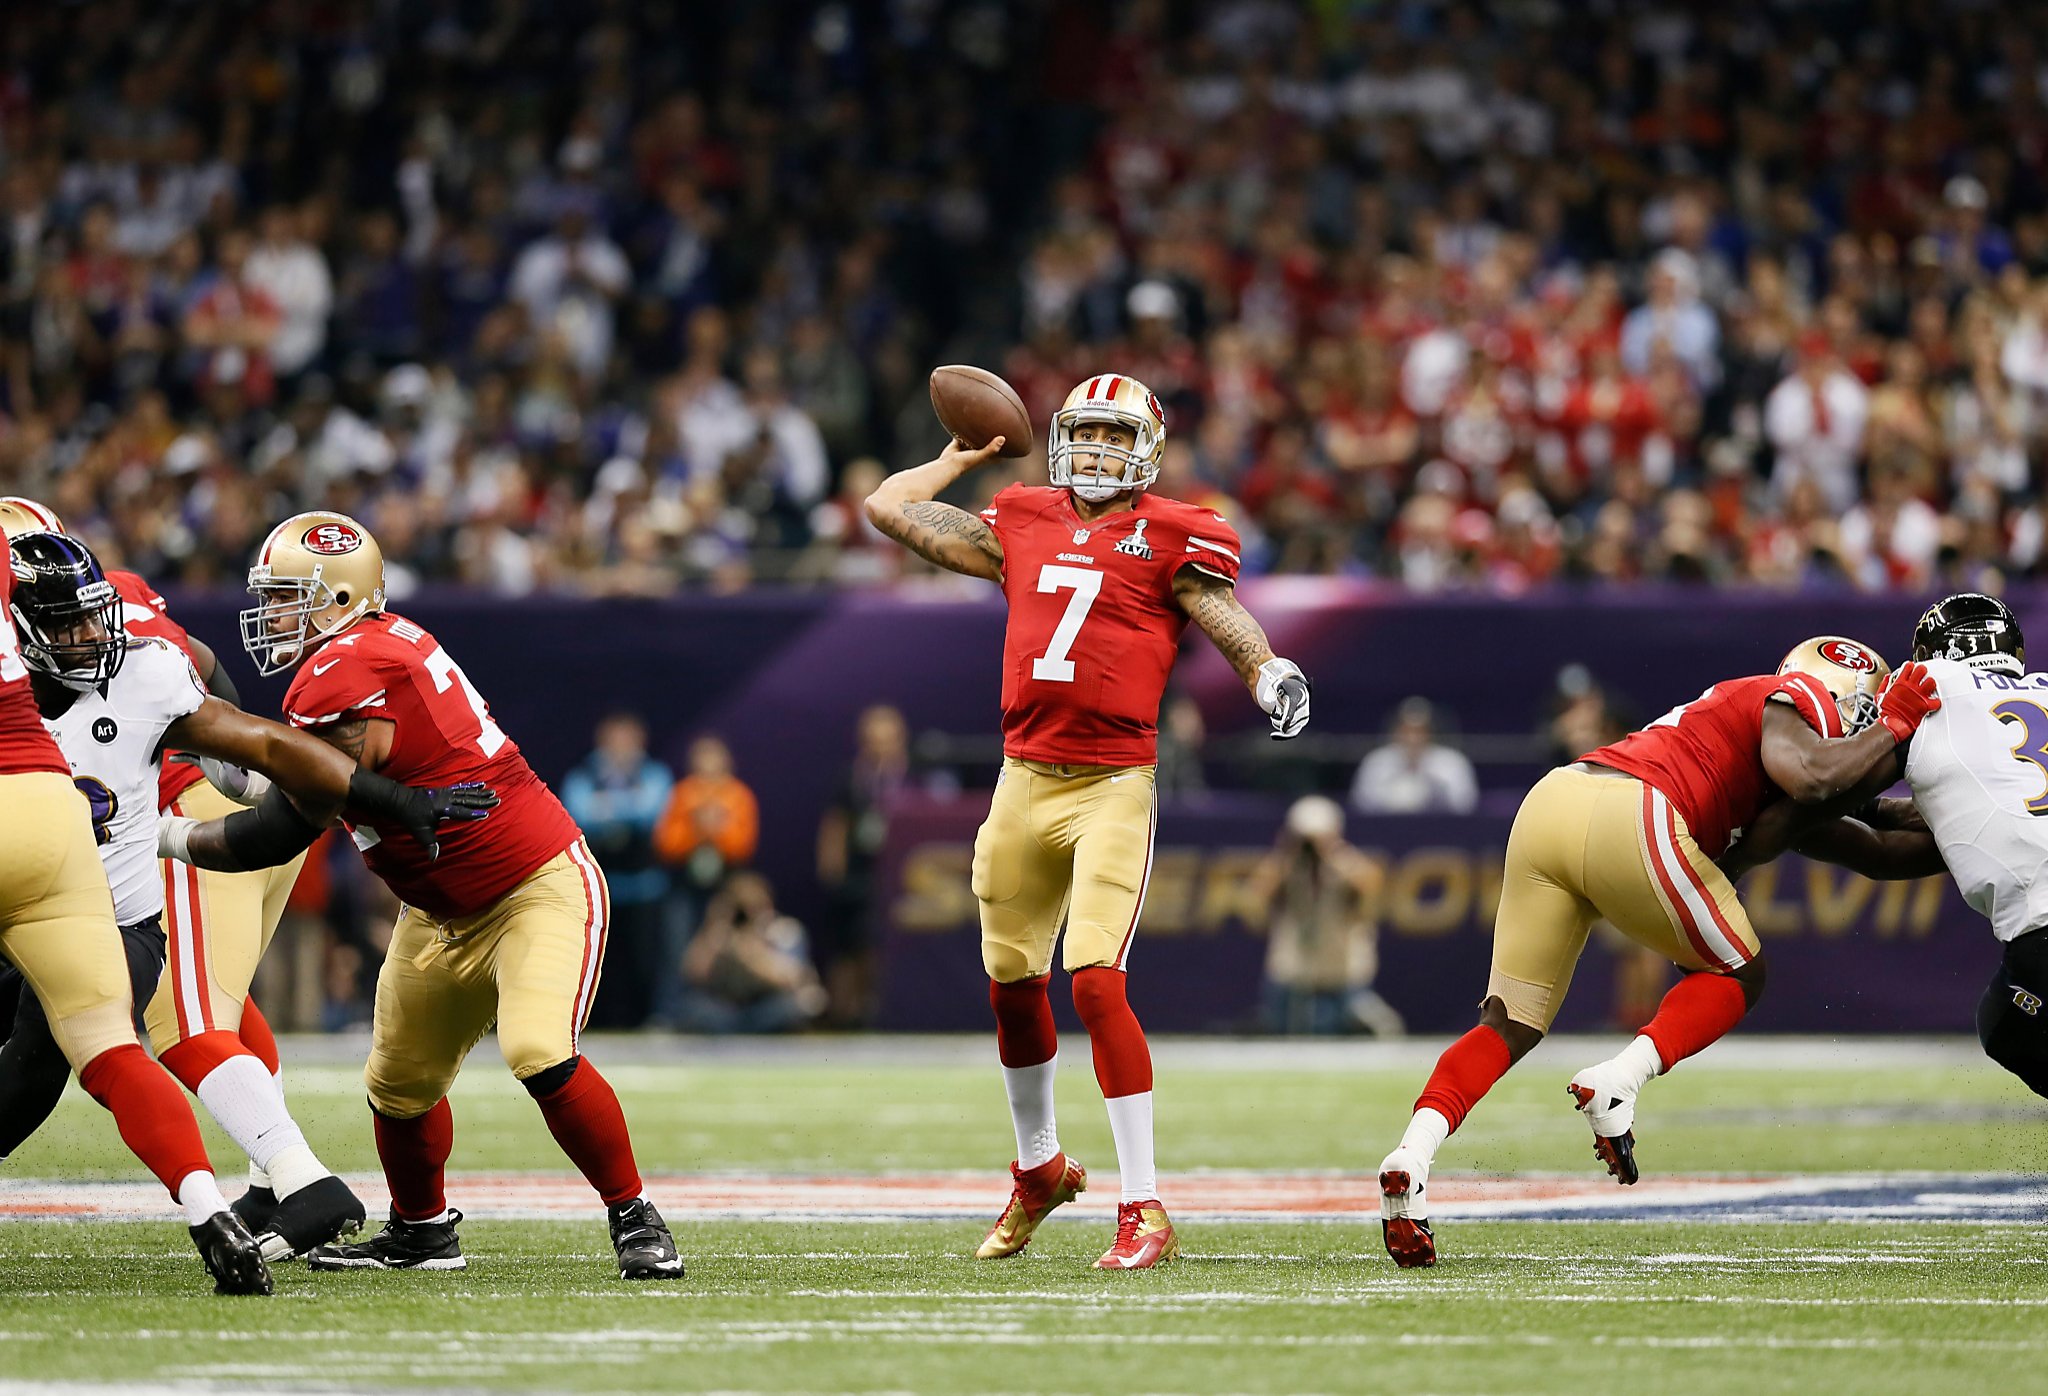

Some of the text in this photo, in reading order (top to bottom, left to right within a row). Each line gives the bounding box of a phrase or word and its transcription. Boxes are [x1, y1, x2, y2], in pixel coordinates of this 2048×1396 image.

[1055, 552, 1095, 565] 49ERS
[1113, 542, 1153, 560] XLVII
[1032, 564, 1104, 683] 7
[1968, 659, 2009, 669] RAVENS
[424, 644, 507, 759] 7
[97, 724, 114, 737] Art
